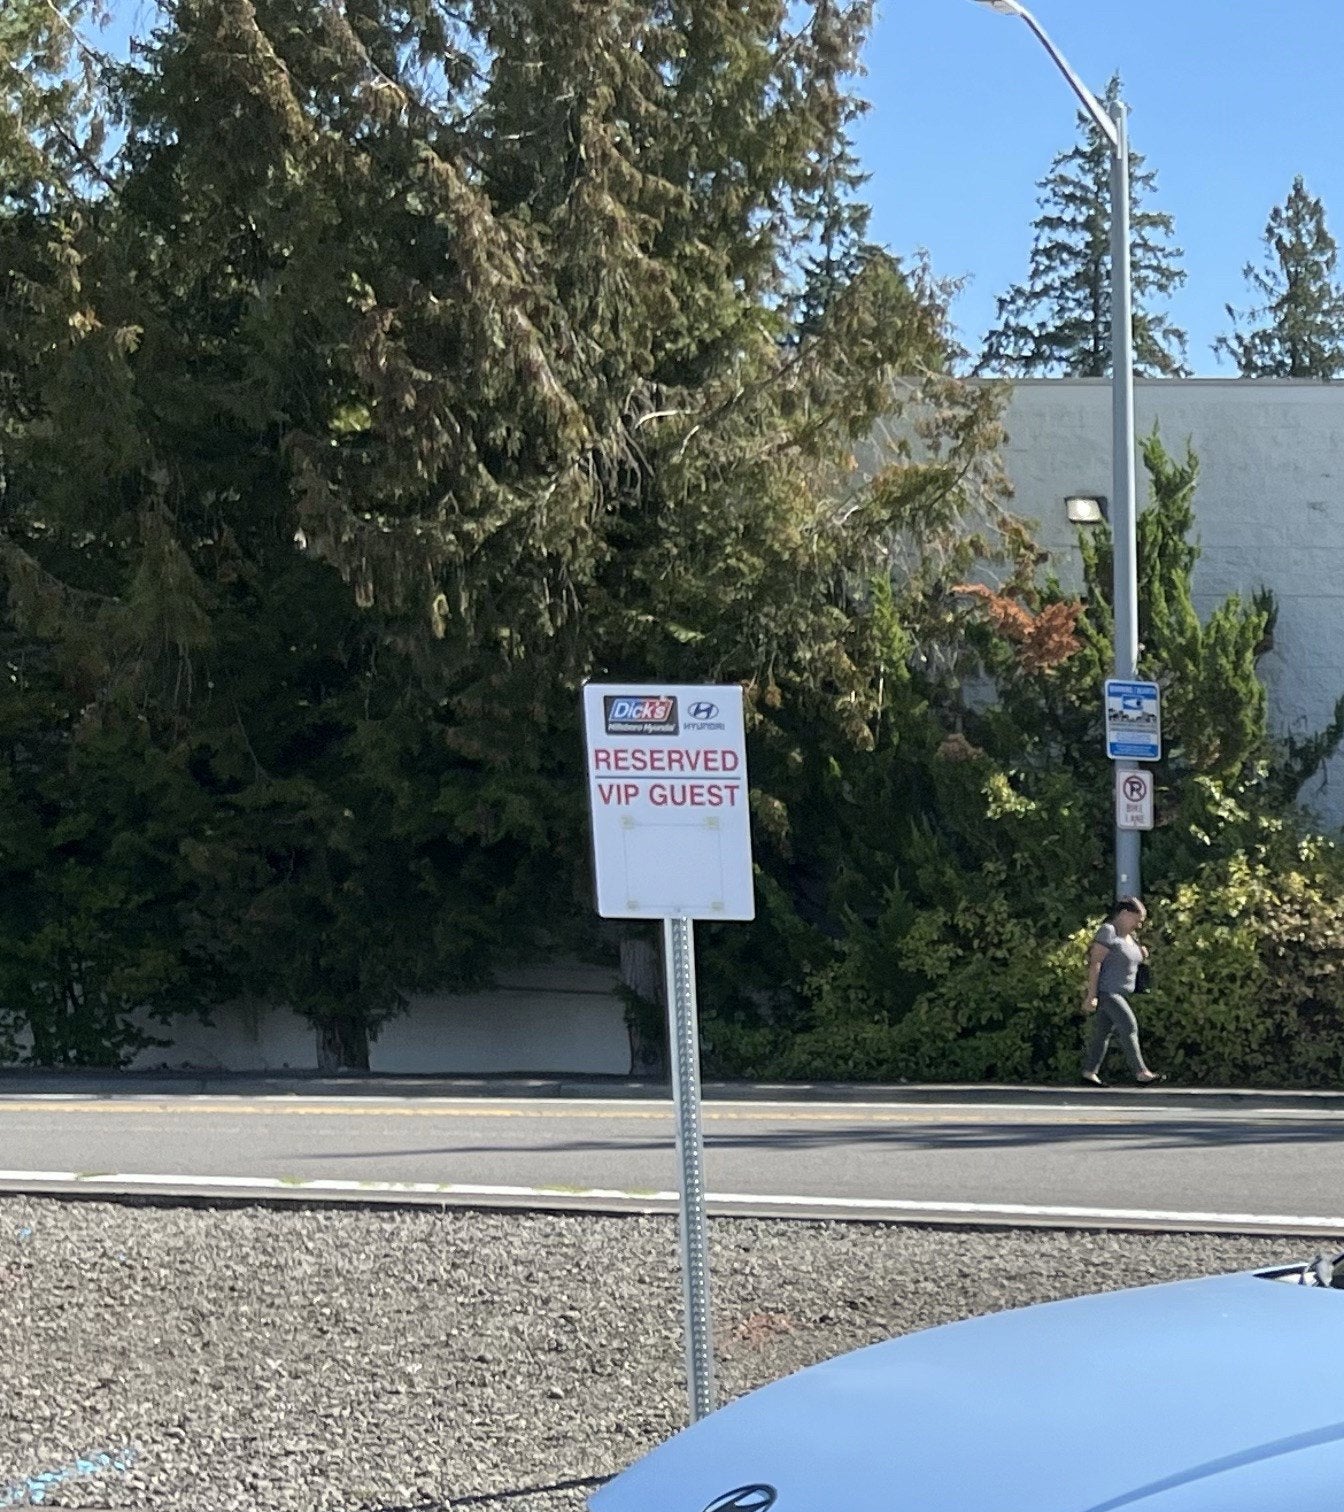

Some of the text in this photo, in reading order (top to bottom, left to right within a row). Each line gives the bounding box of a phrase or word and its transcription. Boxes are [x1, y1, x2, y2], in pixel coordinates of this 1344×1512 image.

[594, 749, 739, 771] RESERVED
[598, 783, 740, 807] VIP GUEST
